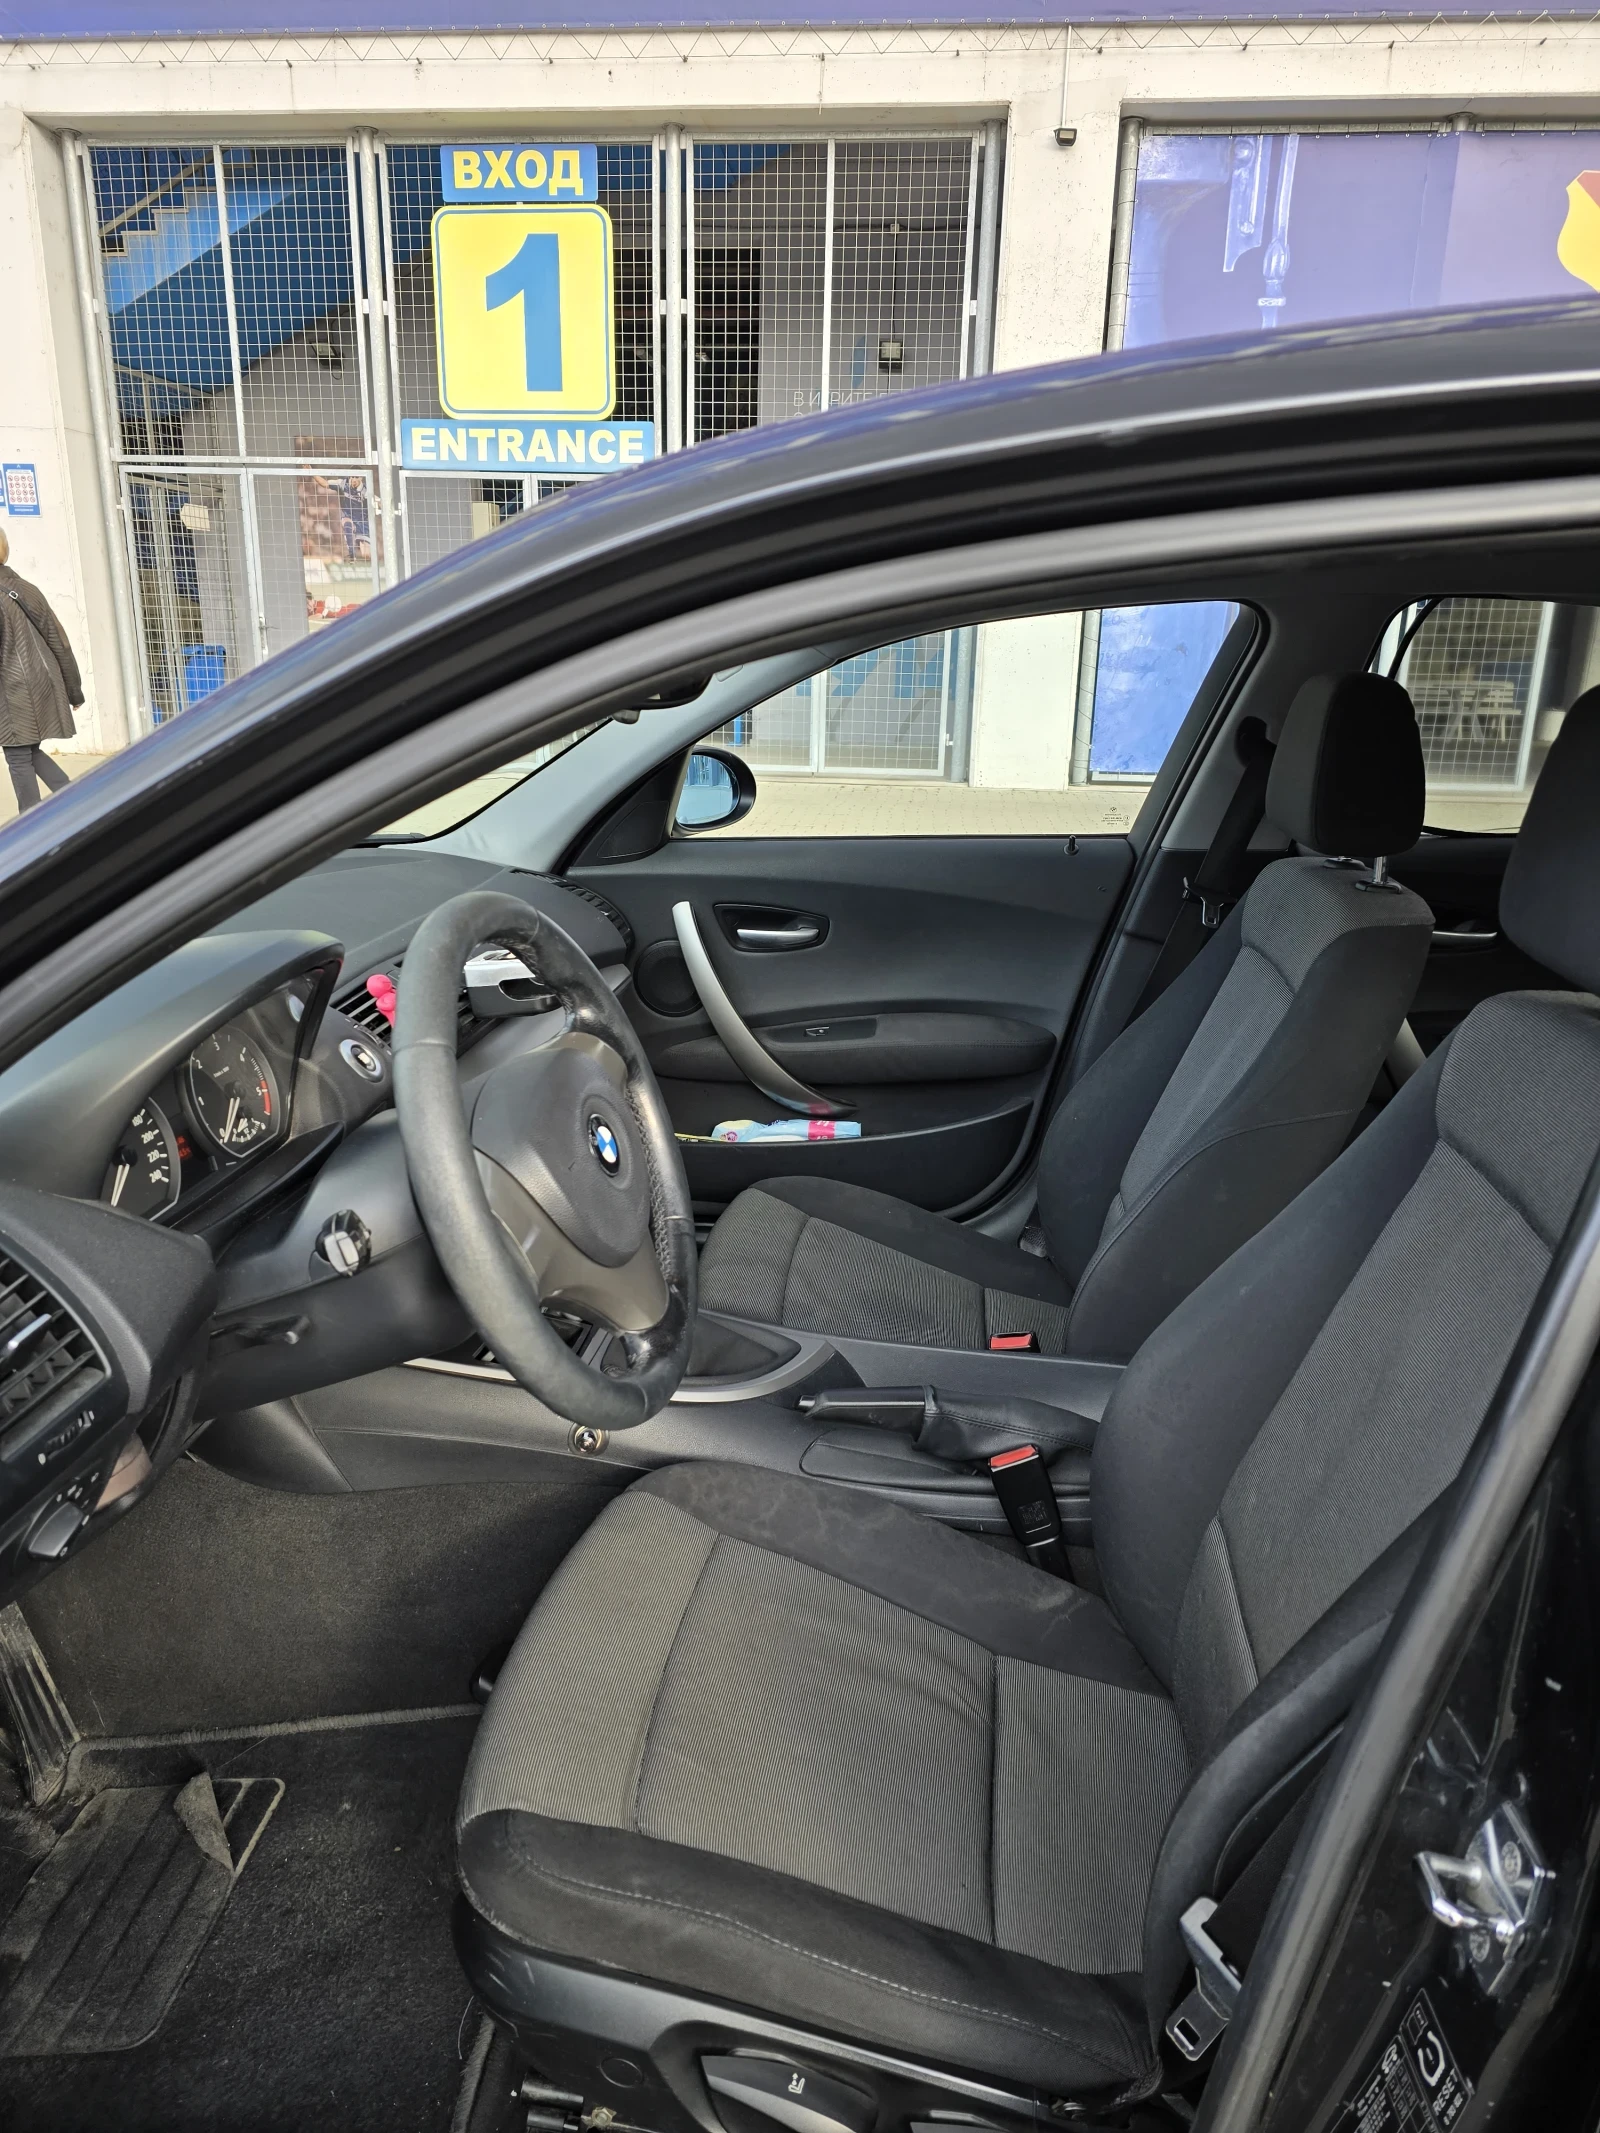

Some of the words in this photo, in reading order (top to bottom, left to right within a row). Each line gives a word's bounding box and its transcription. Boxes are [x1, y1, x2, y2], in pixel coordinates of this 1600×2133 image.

[453, 149, 584, 196] ВХОД
[485, 233, 564, 392] 1
[411, 427, 645, 464] ENTRANCE
[141, 1130, 155, 1144] 200
[147, 1149, 160, 1163] 220
[1432, 2067, 1458, 2116] RESET
